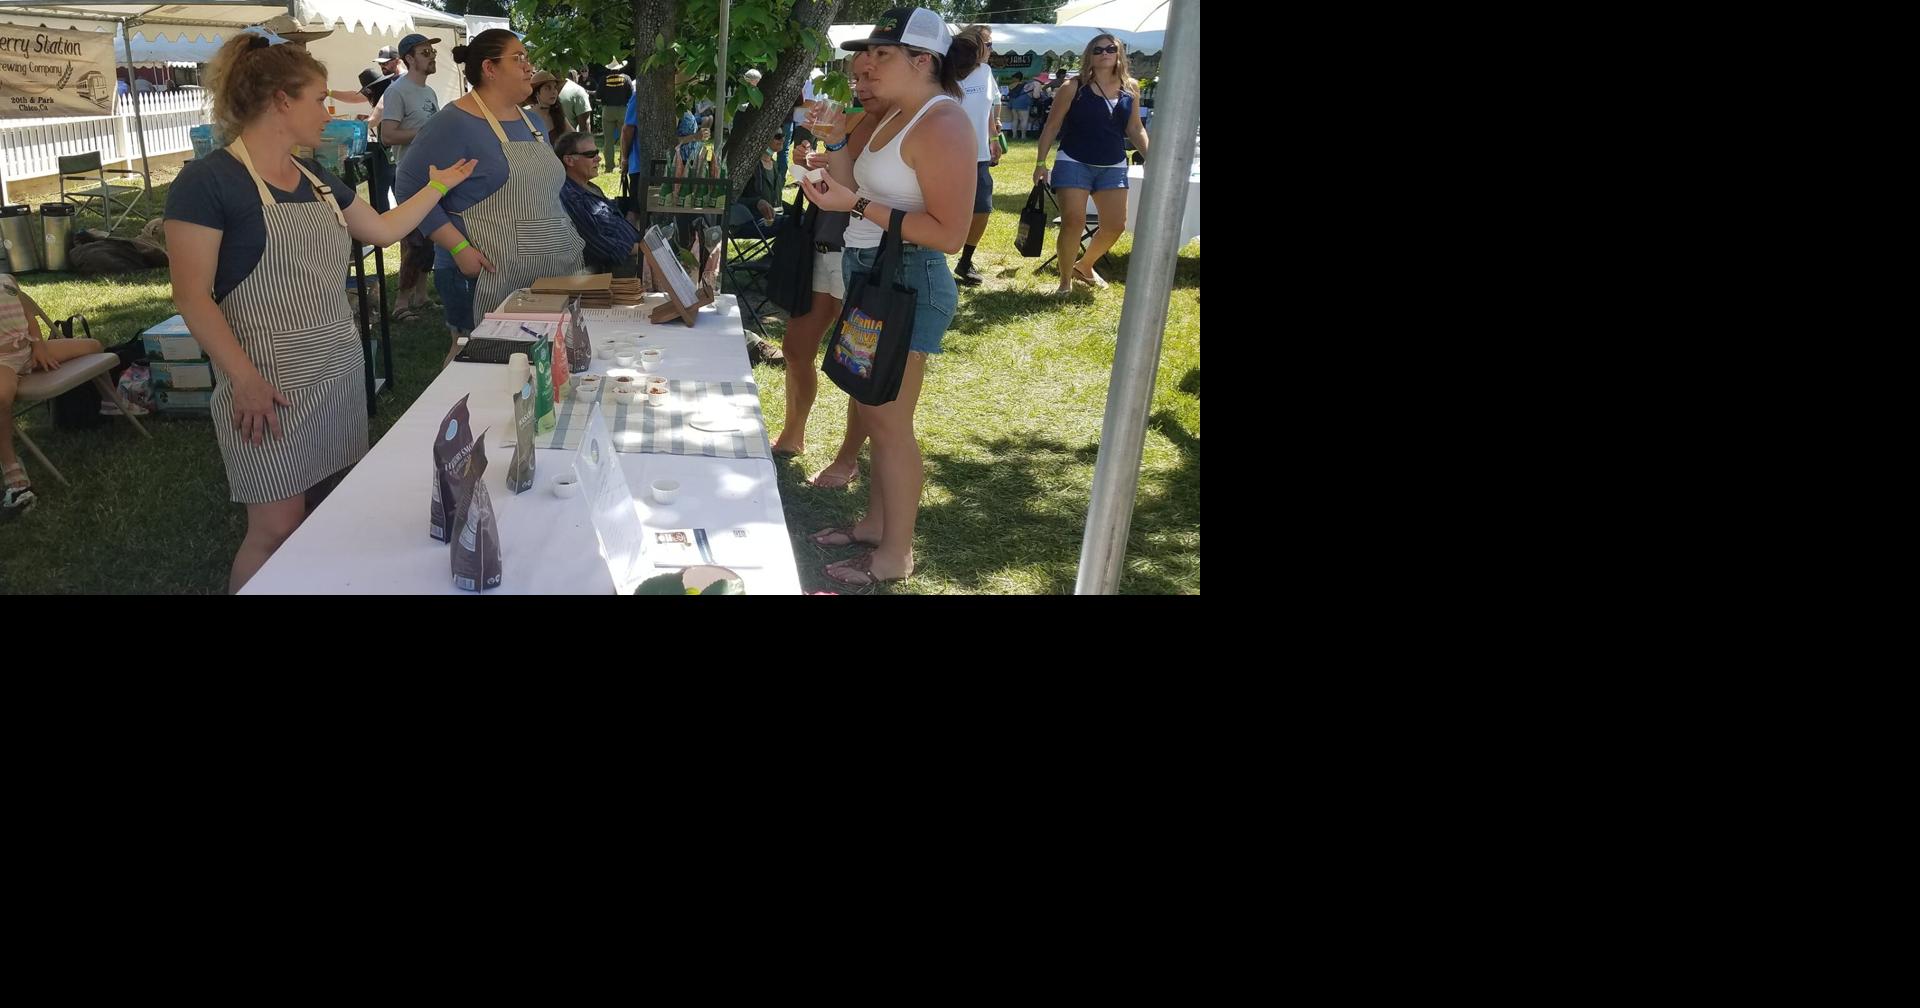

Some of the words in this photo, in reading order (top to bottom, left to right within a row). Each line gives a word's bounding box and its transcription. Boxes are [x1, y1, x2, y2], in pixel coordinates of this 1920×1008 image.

[33, 33, 82, 56] Station
[28, 61, 63, 76] Company
[10, 96, 28, 104] 20th
[29, 96, 36, 104] &
[38, 96, 54, 104] Park
